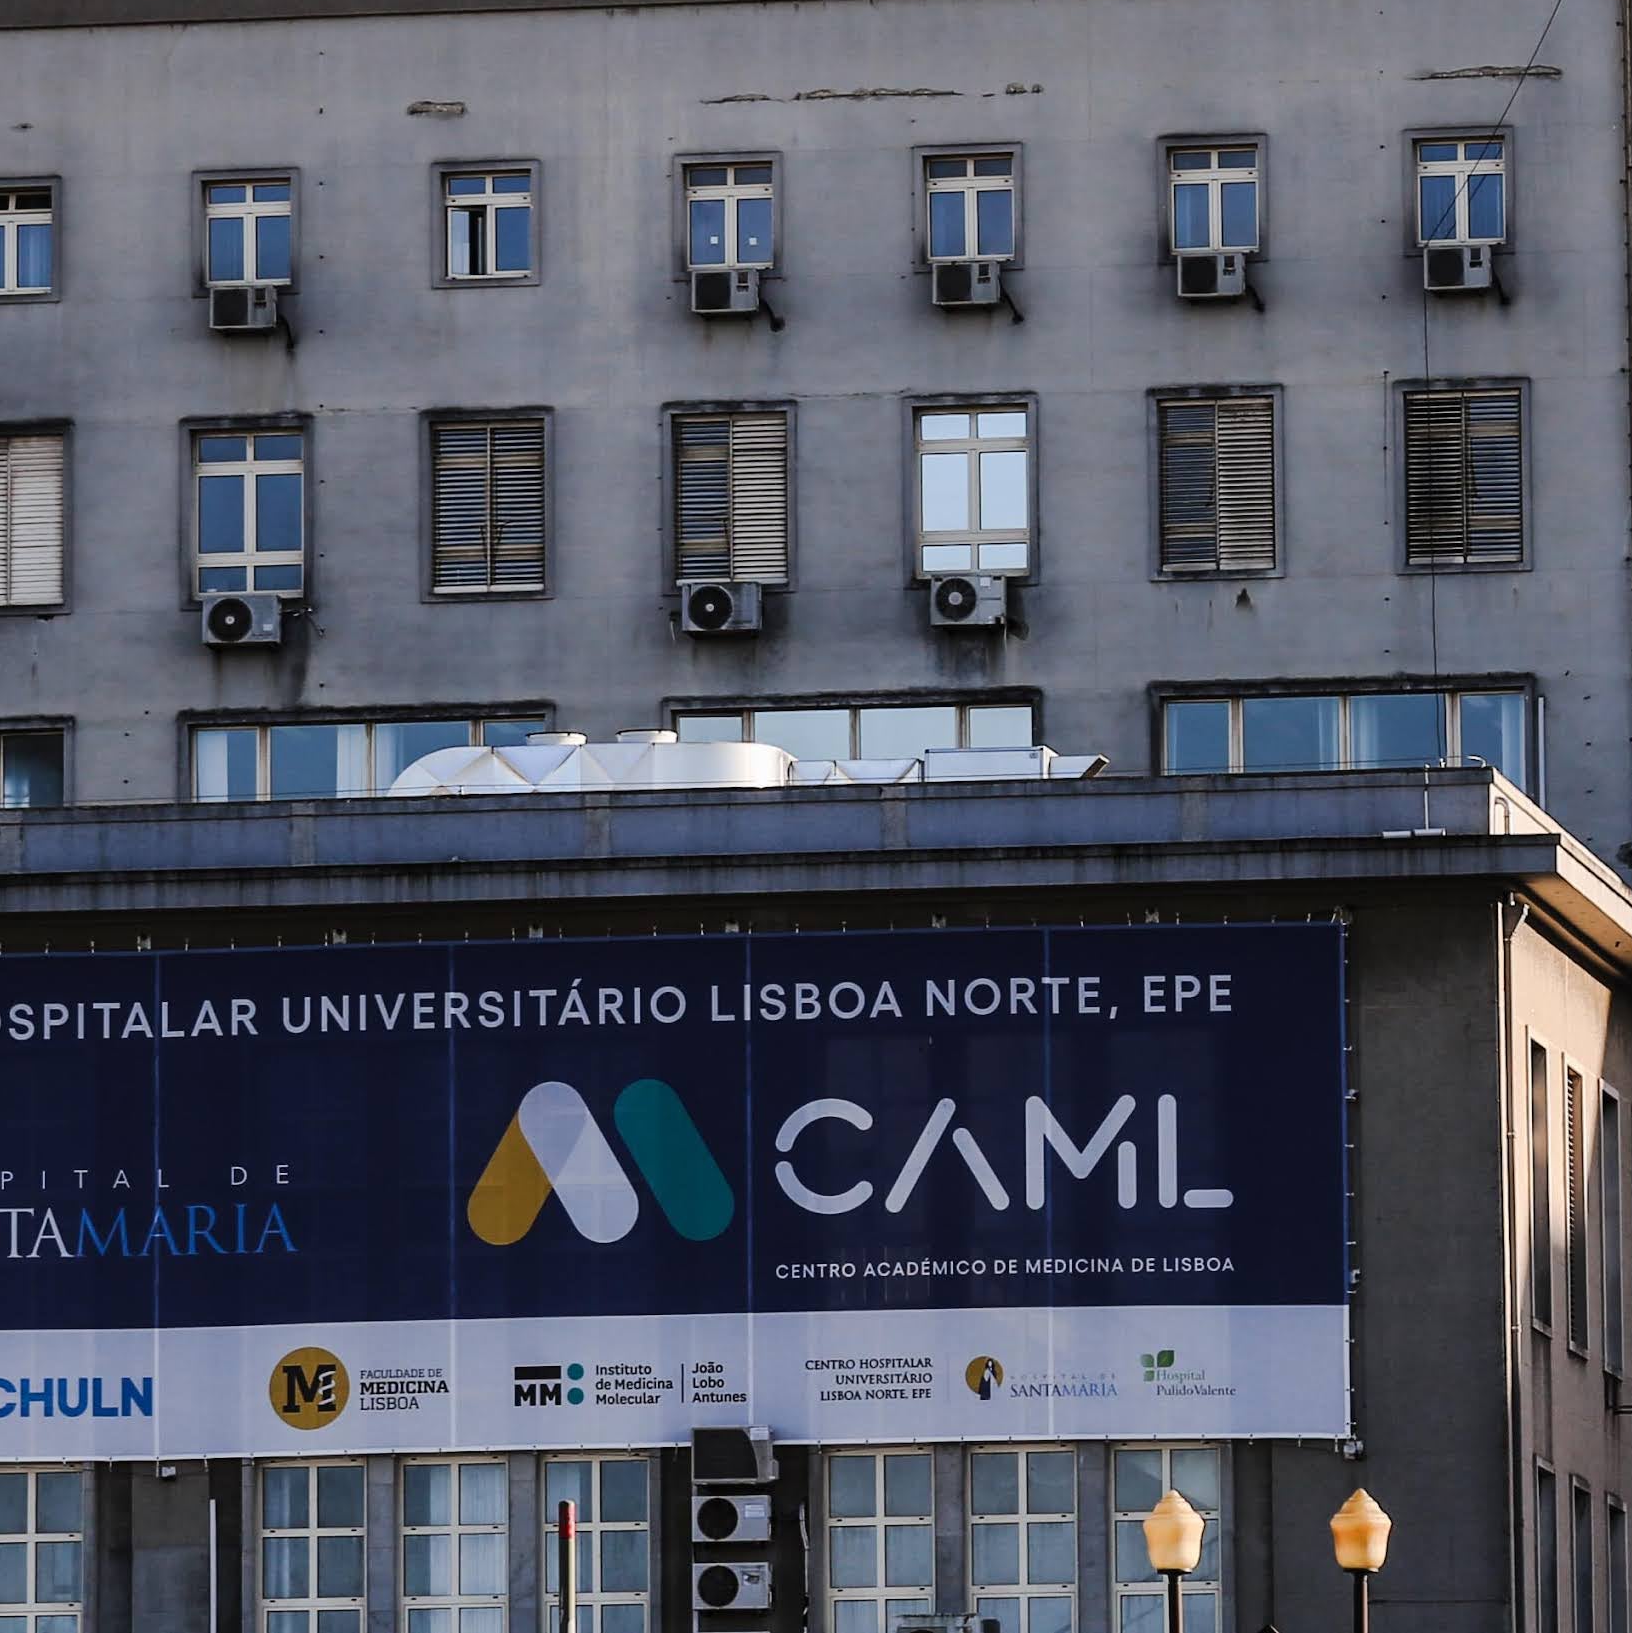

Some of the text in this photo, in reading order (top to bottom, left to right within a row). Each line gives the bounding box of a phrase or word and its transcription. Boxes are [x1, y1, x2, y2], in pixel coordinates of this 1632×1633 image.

[283, 979, 686, 1033] UNIVERSITÁRIO
[712, 981, 902, 1021] LISBOA
[927, 977, 1117, 1019] NORTE,
[1144, 975, 1233, 1013] EPE
[775, 1094, 1233, 1214] CAML
[231, 1165, 288, 1185] DE
[776, 1258, 1234, 1278] CENTRO ACADÉMICO DE MEDICINA DE LISBOA
[596, 1364, 653, 1376] Instituto
[692, 1362, 723, 1373] João
[805, 1358, 932, 1370] CENTRO HOSPITALAR
[360, 1368, 443, 1380] FACULDADE DE
[836, 1372, 932, 1384] UNIVERSITÁRIO
[1156, 1369, 1206, 1383] Hospital
[360, 1380, 449, 1395] MEDICINA
[596, 1378, 673, 1390] de Medicina
[693, 1377, 724, 1388] Lobo
[821, 1391, 861, 1400] LISBOA
[913, 1389, 931, 1398] EPE
[1011, 1384, 1116, 1397] SANTAMARIA
[360, 1396, 420, 1411] LISBOA
[596, 1393, 660, 1404] Molecular
[693, 1393, 746, 1402] Antunes
